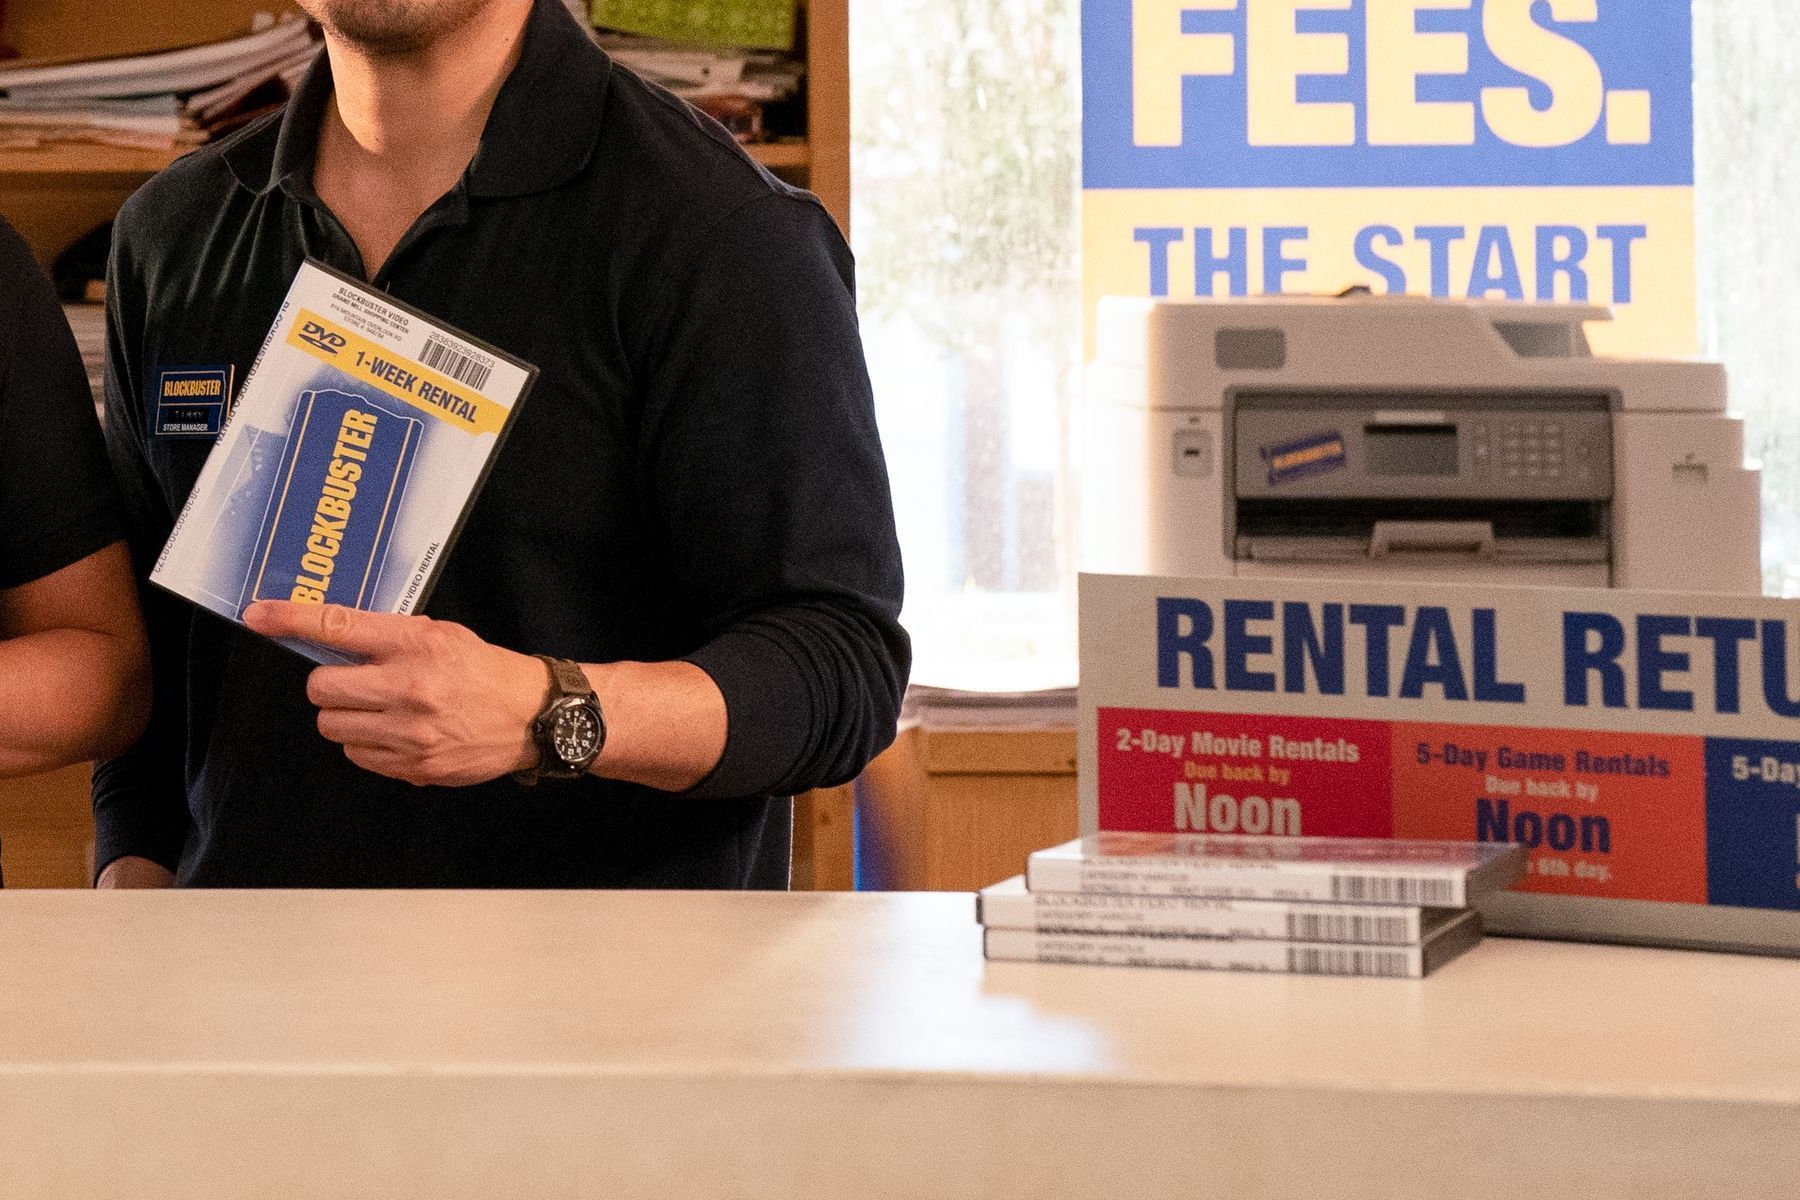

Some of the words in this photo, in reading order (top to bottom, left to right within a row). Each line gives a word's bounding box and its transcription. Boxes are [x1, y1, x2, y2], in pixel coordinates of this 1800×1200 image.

[1133, 227, 1308, 298] THE
[1354, 224, 1647, 304] START
[338, 287, 387, 315] BLOCKBUSTER
[387, 311, 409, 326] VIDEO
[301, 320, 347, 350] DVD
[164, 380, 221, 397] BLOCKBUSTER
[352, 348, 422, 394] 1-WEEK
[417, 380, 481, 423] RENTAL
[181, 424, 208, 432] MANAGER
[290, 407, 378, 604] BLOCKBUSTER
[404, 573, 423, 600] VIDEO
[418, 541, 439, 573] RENTAL
[1156, 596, 1526, 703] RENTAL
[1116, 727, 1185, 758] 2-Day
[1191, 731, 1262, 757] Movie
[1268, 734, 1360, 763] Rentals
[1416, 742, 1488, 772] 5-Day
[1497, 746, 1566, 773] Game
[1575, 750, 1671, 778] Rentals
[1173, 782, 1301, 836] Noon
[1476, 798, 1611, 853] Noon
